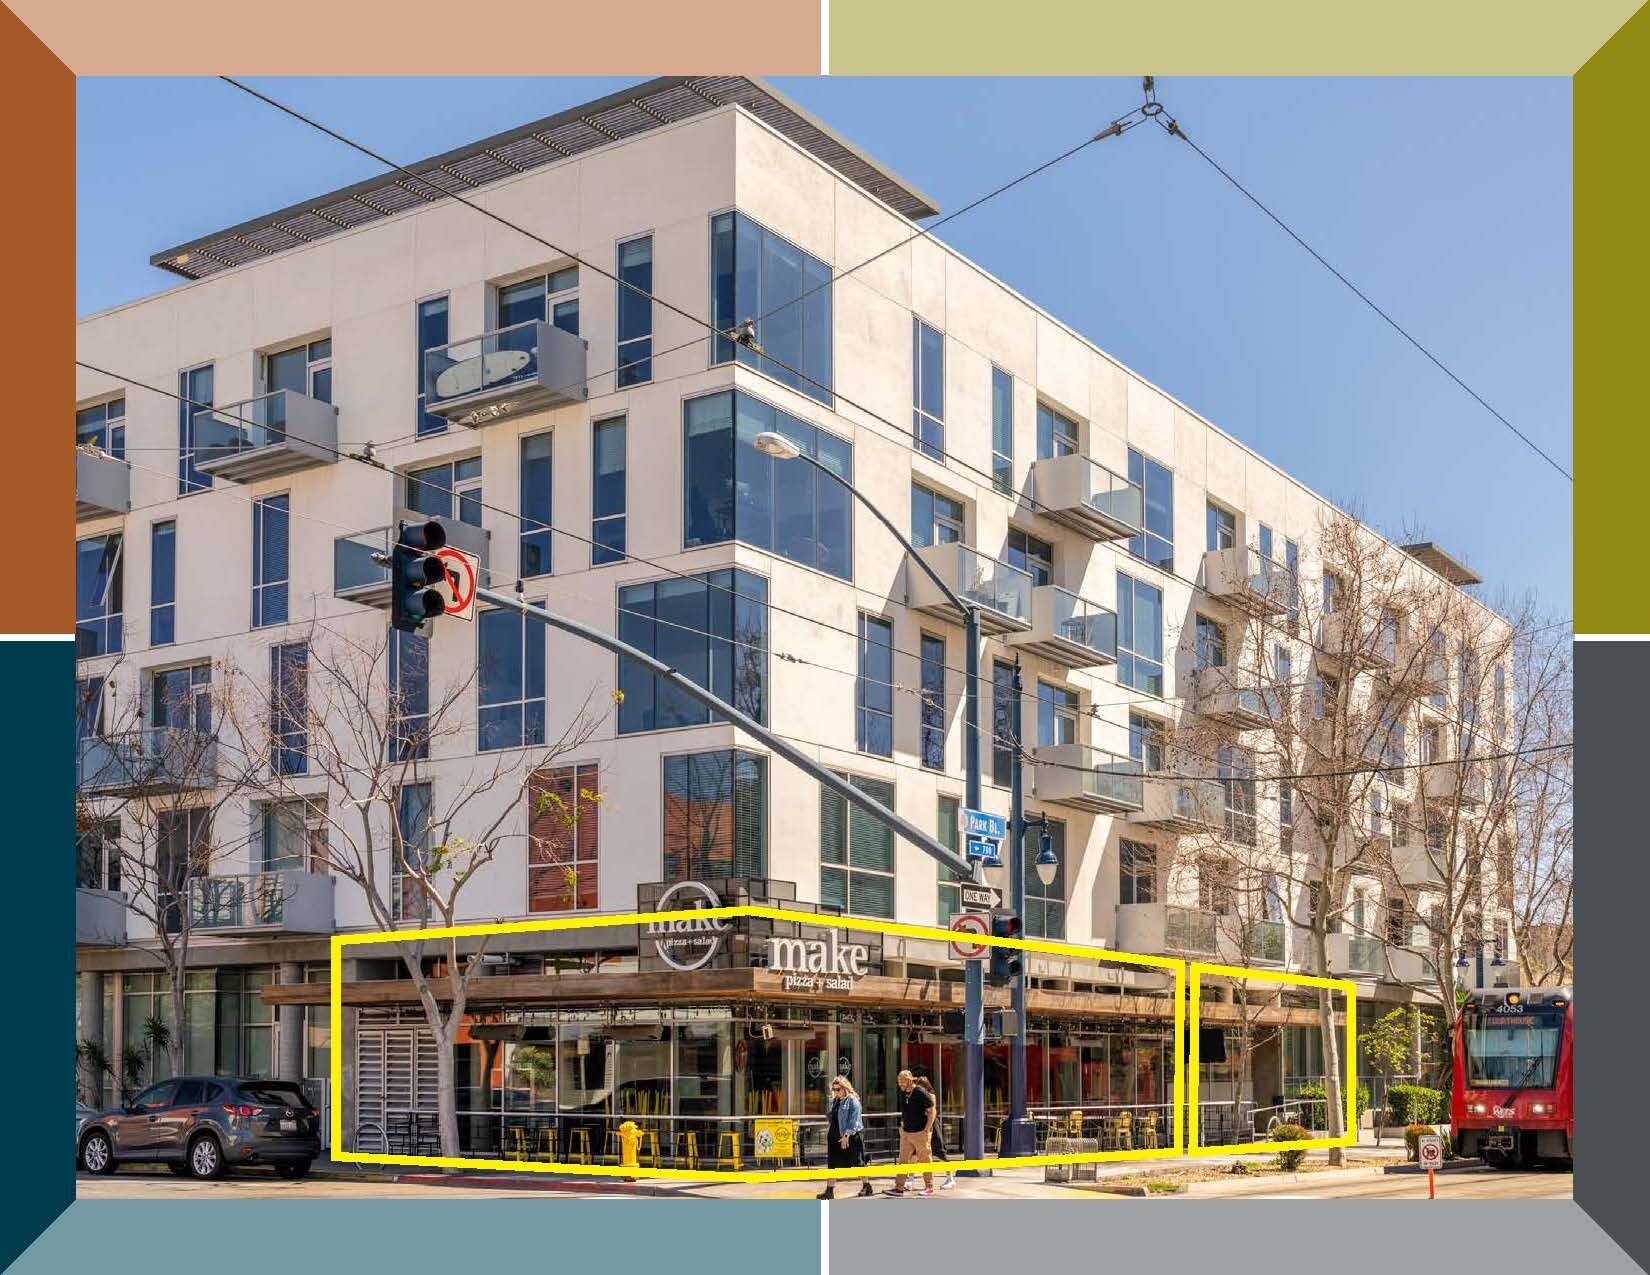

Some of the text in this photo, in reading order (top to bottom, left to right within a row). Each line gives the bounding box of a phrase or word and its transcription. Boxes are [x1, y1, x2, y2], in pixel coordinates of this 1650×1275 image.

[970, 815, 987, 831] PARK
[965, 890, 991, 903] ONE WAY
[666, 937, 687, 949] pizza
[767, 927, 869, 976] make
[785, 972, 814, 990] pizza
[826, 974, 855, 991] salad
[1496, 1005, 1523, 1013] 4053
